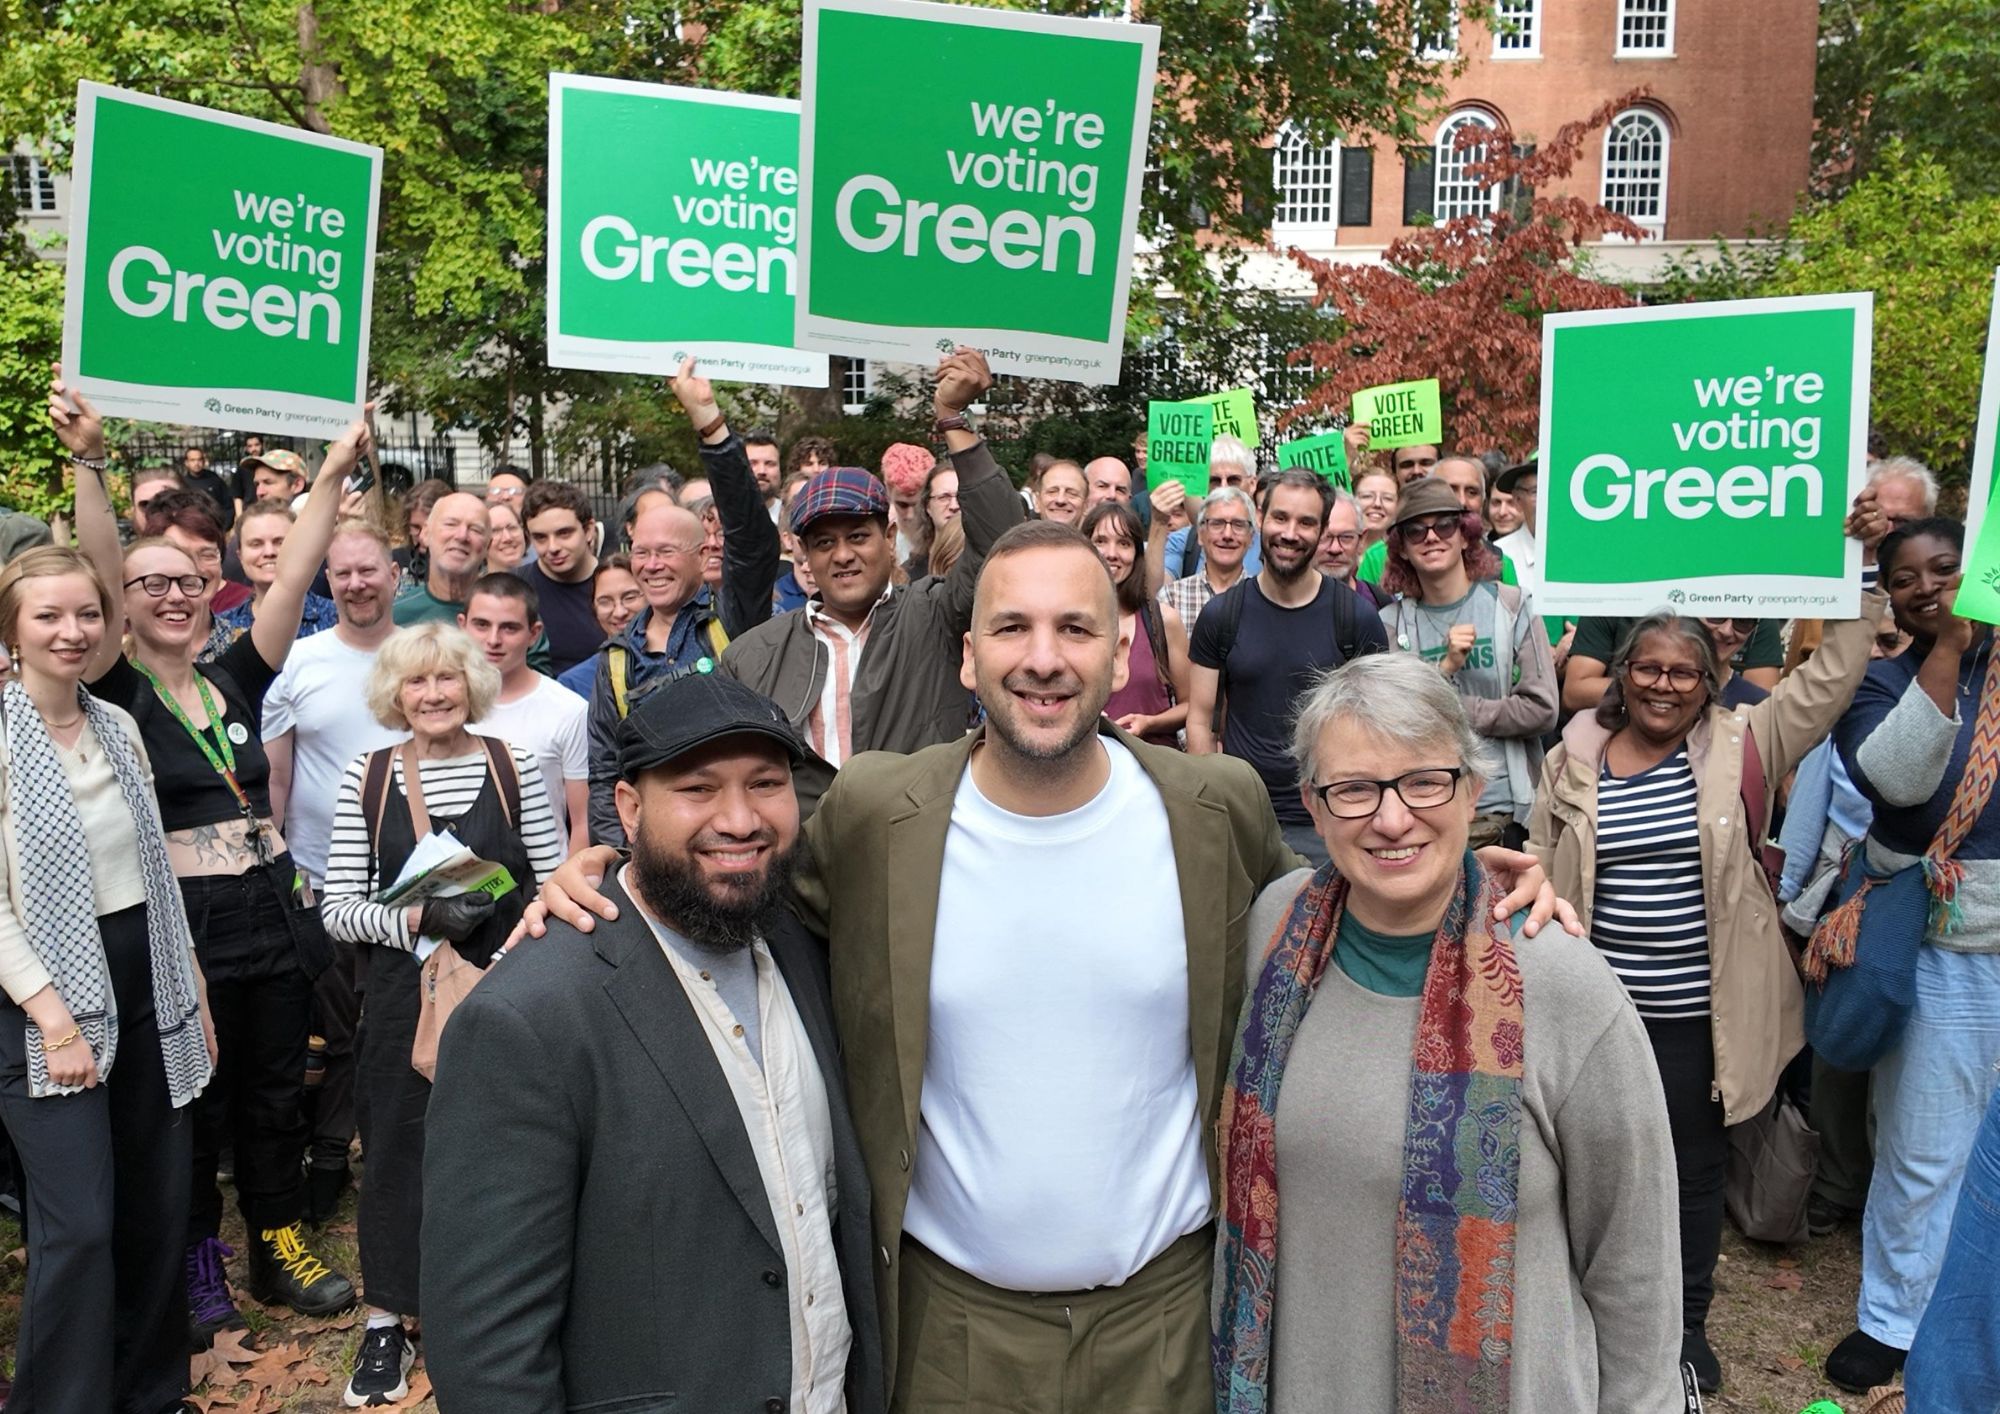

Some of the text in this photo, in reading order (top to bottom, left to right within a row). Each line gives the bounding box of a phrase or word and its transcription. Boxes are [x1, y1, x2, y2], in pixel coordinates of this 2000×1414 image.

[947, 148, 1098, 212] voting
[673, 194, 796, 245] voting
[836, 174, 1095, 275] Green
[213, 229, 341, 290] voting
[580, 214, 797, 296] Green
[108, 245, 341, 345] Green
[697, 357, 720, 366] reen
[721, 358, 745, 369] Party
[992, 347, 1022, 362] Party
[1025, 352, 1101, 369] greenparty.org.uk
[224, 403, 254, 415] Green
[255, 406, 282, 419] Party
[1212, 400, 1233, 421] TE
[1374, 390, 1416, 415] VOTE
[1159, 413, 1204, 437] VOTE
[1371, 413, 1424, 439] GREEN
[1673, 410, 1820, 459] voting
[1151, 440, 1209, 464] GREEN
[1289, 444, 1338, 470] VOTE
[1570, 454, 1823, 521] Green
[1689, 593, 1839, 606] Green Party greenparty.org.uk
